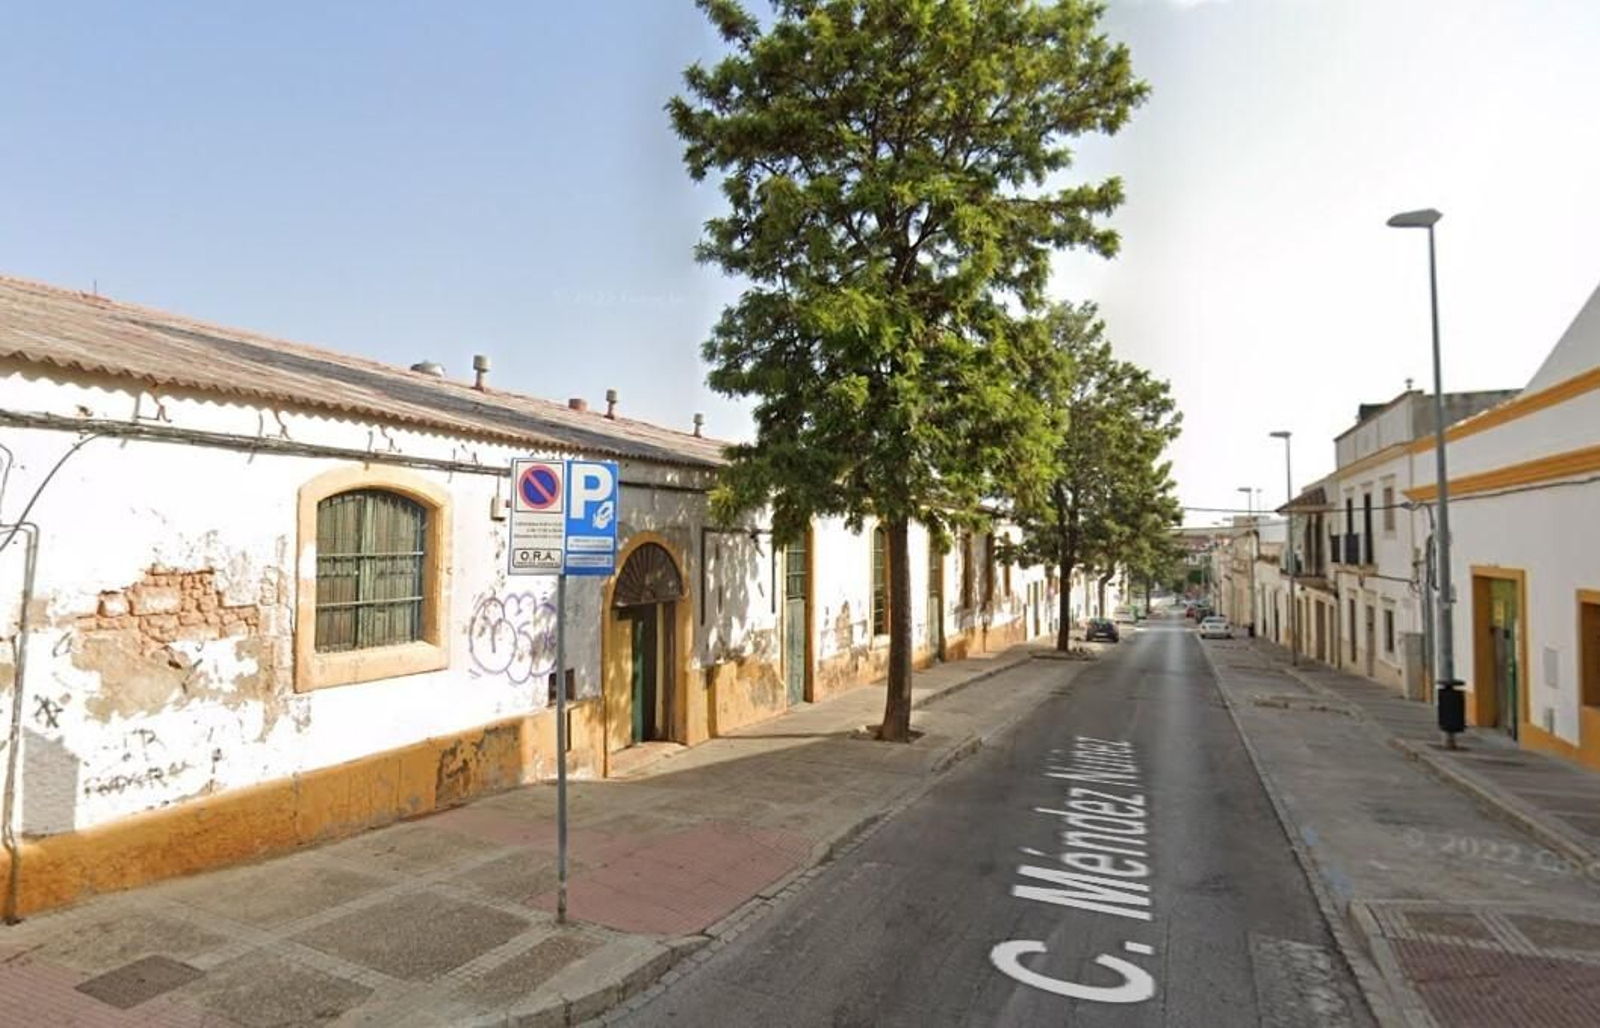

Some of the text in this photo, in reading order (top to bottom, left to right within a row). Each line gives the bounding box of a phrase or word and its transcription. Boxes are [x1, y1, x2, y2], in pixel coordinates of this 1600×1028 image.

[569, 464, 613, 519] P
[1011, 787, 1154, 921] Méndez
[989, 939, 1155, 1003] C.
